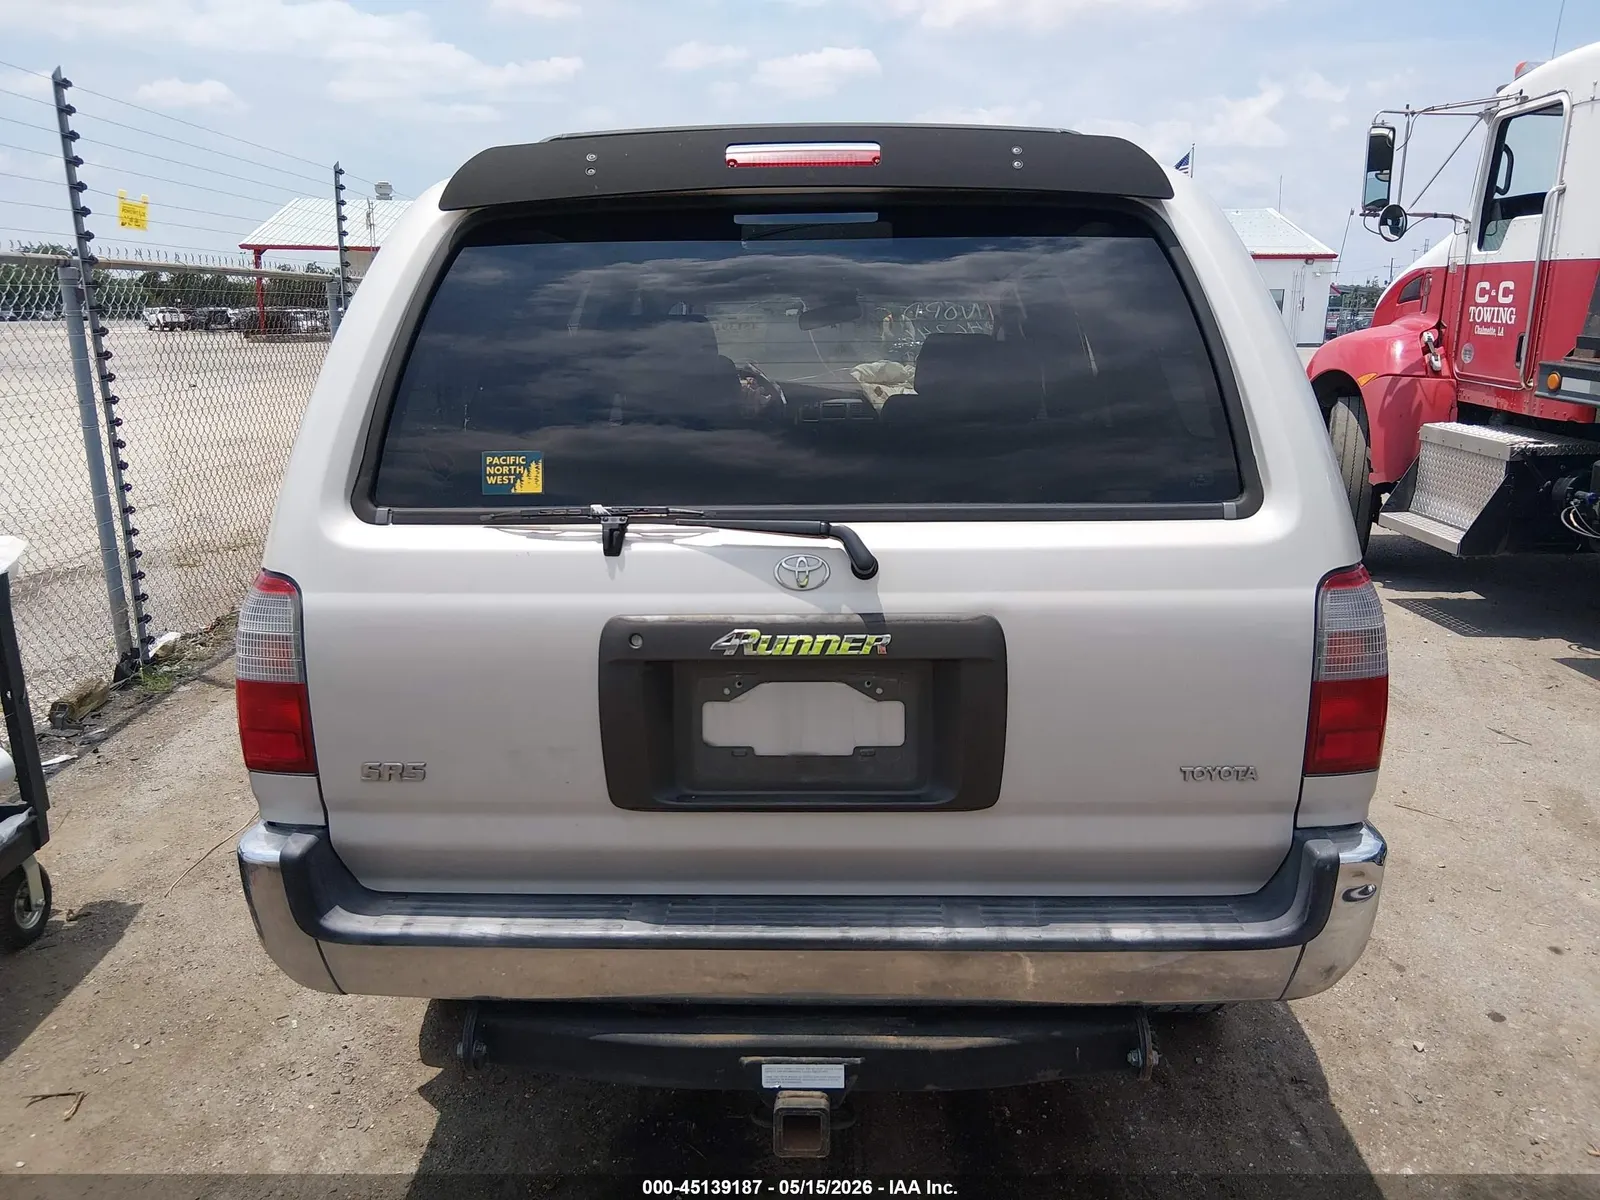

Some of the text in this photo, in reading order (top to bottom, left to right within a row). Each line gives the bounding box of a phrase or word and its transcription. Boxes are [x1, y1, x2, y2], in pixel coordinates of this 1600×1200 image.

[1468, 306, 1516, 325] TOWING
[486, 456, 526, 465] PACIFIC
[486, 466, 524, 475] NORTH
[486, 475, 515, 485] WEST
[361, 762, 427, 782] SR5
[1179, 765, 1259, 782] TOYOTA
